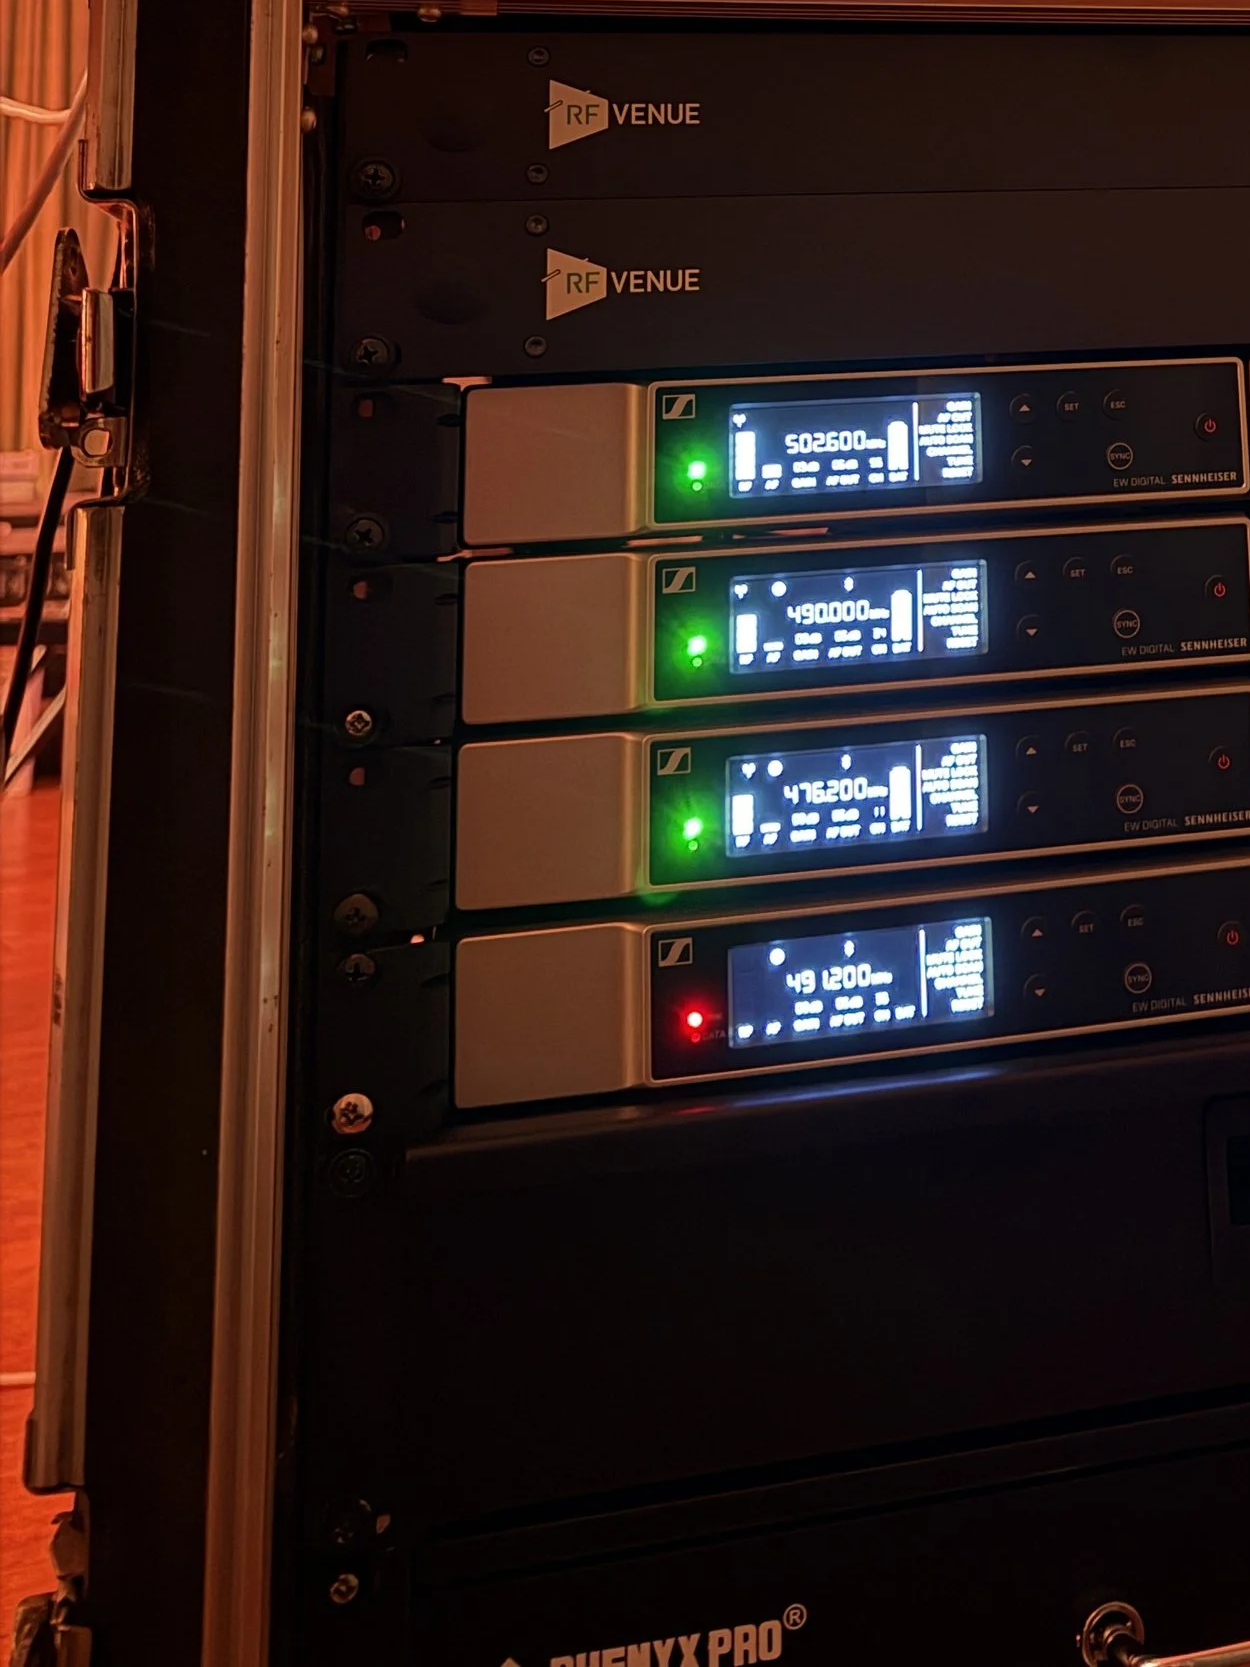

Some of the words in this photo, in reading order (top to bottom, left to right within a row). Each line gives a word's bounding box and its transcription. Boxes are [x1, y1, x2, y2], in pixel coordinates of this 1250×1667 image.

[567, 104, 599, 125] RF
[612, 102, 700, 125] VENUE
[567, 272, 600, 294] RF
[610, 269, 700, 294] VENUE
[1113, 478, 1130, 488] EW
[1130, 476, 1166, 486] DIGITAL
[1171, 471, 1238, 485] SENNHEISER
[1139, 643, 1174, 655] DIGITAL
[1180, 637, 1247, 652] SENNHEISER
[1141, 818, 1178, 830] DIGITAL
[1150, 997, 1187, 1011] DIGITAL
